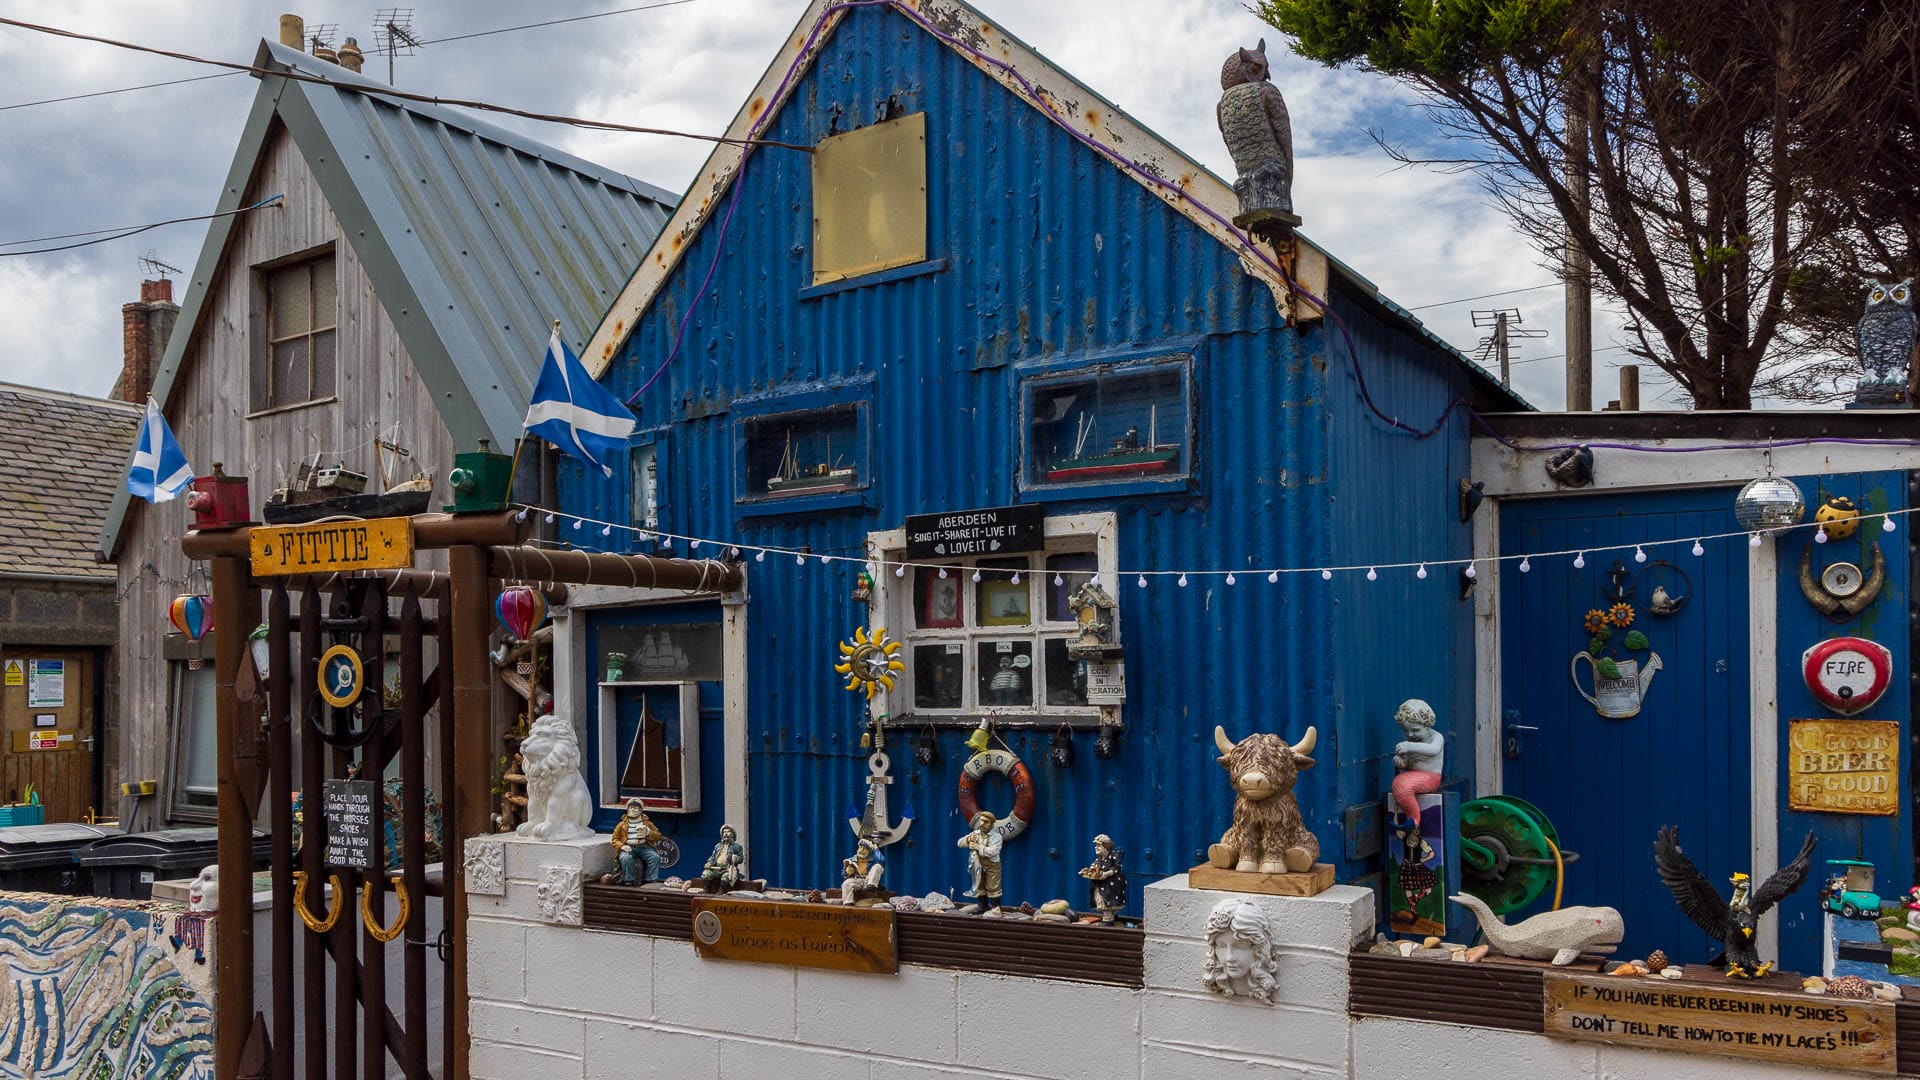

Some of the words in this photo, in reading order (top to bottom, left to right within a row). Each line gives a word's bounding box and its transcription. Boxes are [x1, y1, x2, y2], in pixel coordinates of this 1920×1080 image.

[938, 512, 997, 528] ABERDEEN
[279, 527, 368, 565] FITTIE
[950, 541, 974, 554] LOVE
[976, 540, 986, 552] IT
[1091, 667, 1108, 675] CCTV
[1826, 661, 1866, 675] FIRE
[1599, 679, 1635, 690] WELCOME
[1825, 734, 1889, 751] GOOD
[1798, 752, 1888, 773] BEER
[1824, 775, 1889, 793] GOOD
[330, 794, 347, 802] PLACE
[352, 795, 368, 803] YOUR
[329, 803, 344, 811] HANDS
[346, 804, 370, 813] THROUGH
[330, 814, 340, 822] THE
[344, 815, 369, 825] HORSES
[339, 824, 360, 834] SHOES
[330, 836, 345, 846] MAKE
[346, 838, 351, 846] A
[352, 837, 369, 846] WISH
[352, 849, 364, 857] THE
[329, 856, 346, 865] GOOD
[348, 857, 367, 866] NEWS
[779, 937, 799, 950] as
[1574, 985, 1588, 998] IF
[1593, 986, 1622, 1002] YOU
[1624, 991, 1660, 1006] HAVE
[1661, 993, 1708, 1010] NEVER
[1709, 998, 1750, 1013] BEEN
[1751, 1002, 1765, 1014] IN
[1769, 1004, 1792, 1018] MY
[1572, 1013, 1616, 1033] DON'T
[1620, 1020, 1654, 1037] TELL
[1657, 1023, 1680, 1040] ME
[1762, 1031, 1784, 1047] MY
